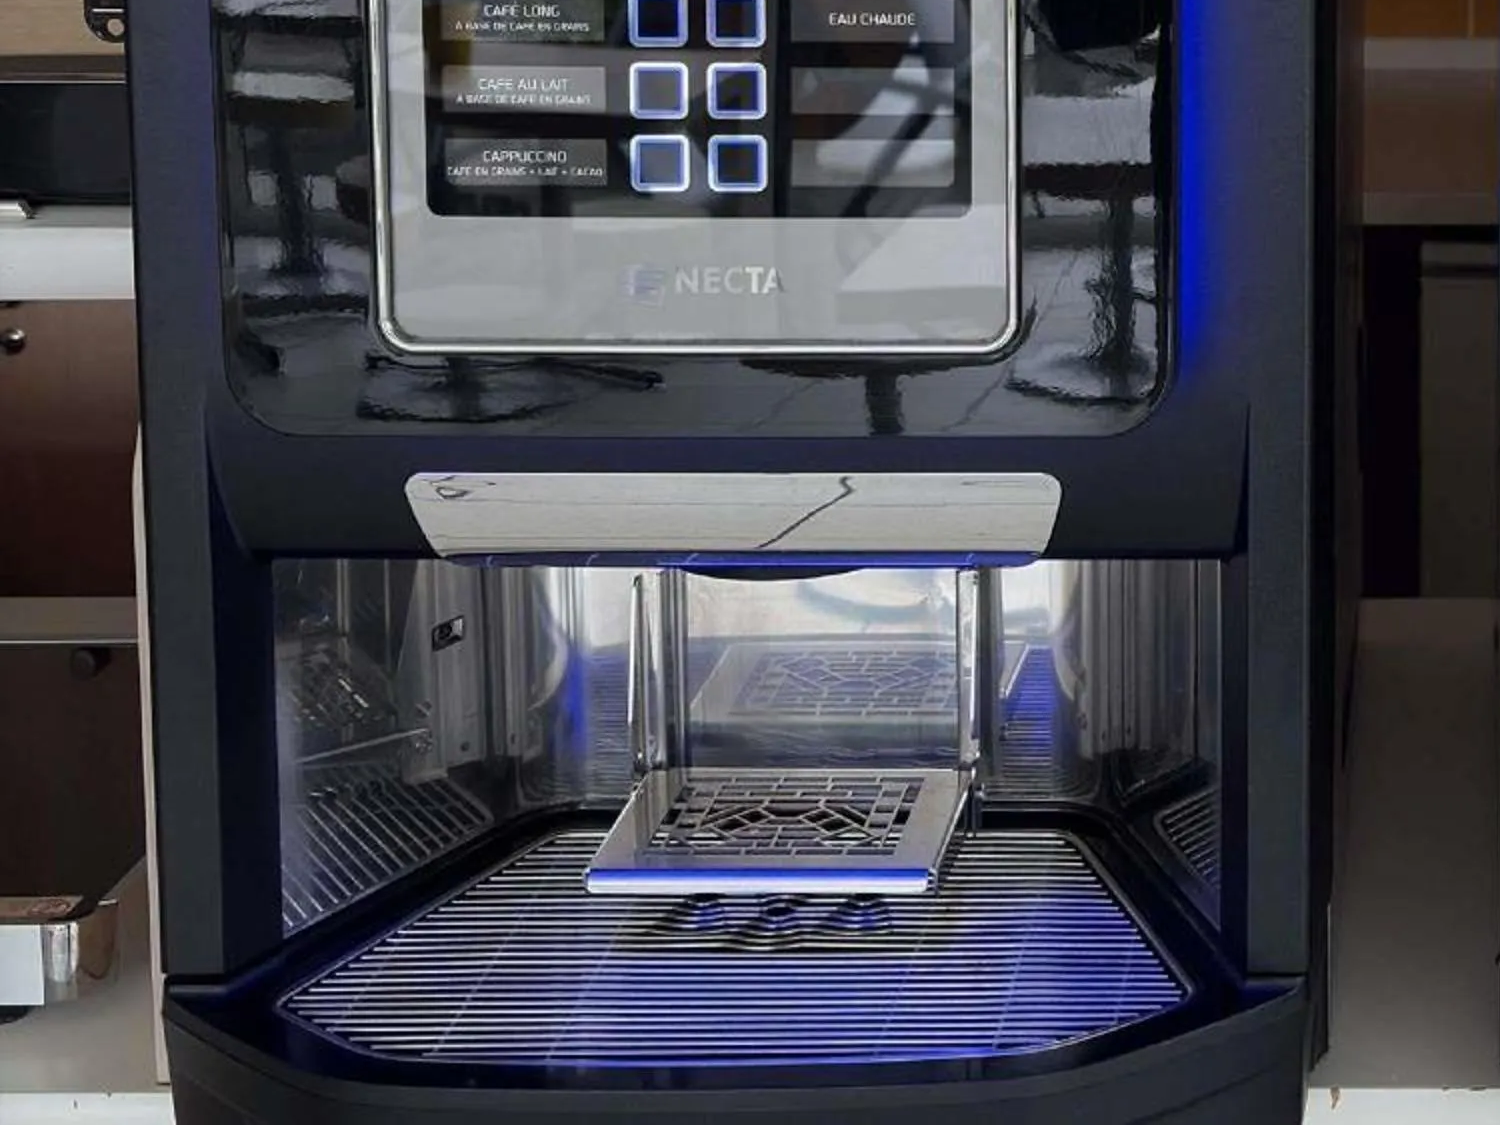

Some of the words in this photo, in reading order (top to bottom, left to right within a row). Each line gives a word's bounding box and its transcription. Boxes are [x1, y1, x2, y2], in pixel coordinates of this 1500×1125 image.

[523, 4, 561, 17] LONG
[828, 12, 858, 26] EAU
[860, 12, 916, 26] CHAUDE
[517, 78, 537, 91] AU
[675, 266, 785, 294] NECTA
